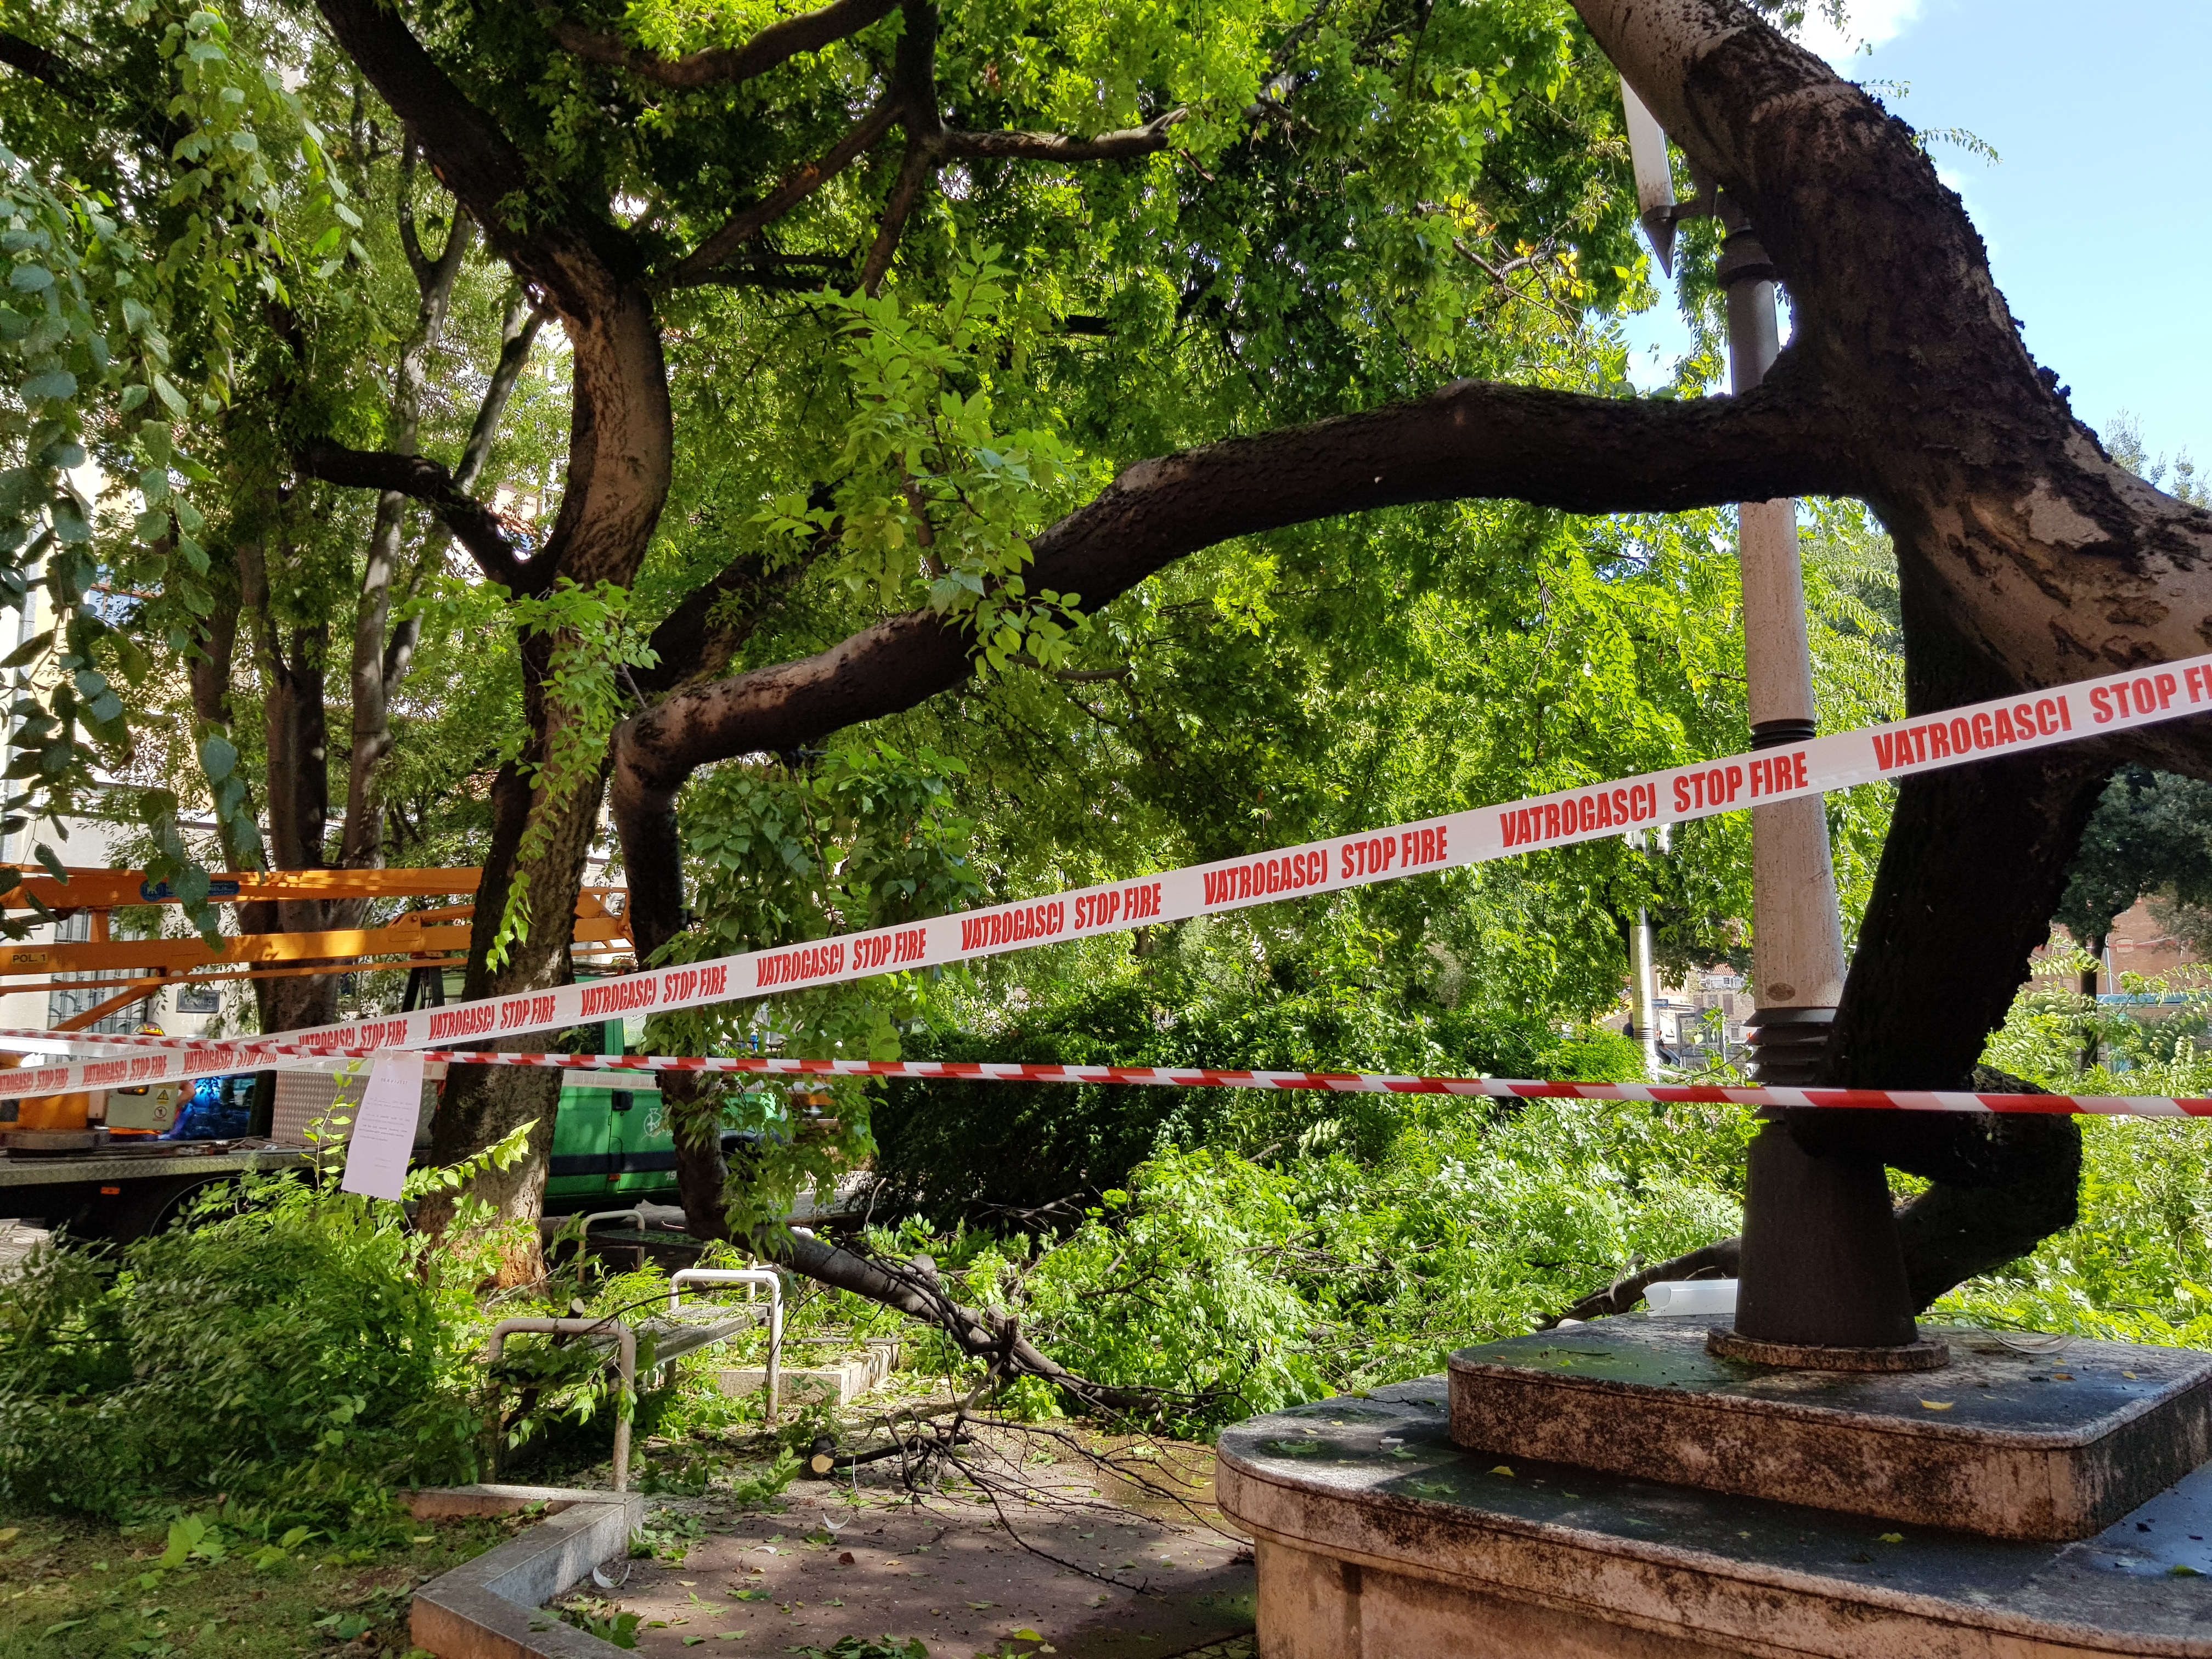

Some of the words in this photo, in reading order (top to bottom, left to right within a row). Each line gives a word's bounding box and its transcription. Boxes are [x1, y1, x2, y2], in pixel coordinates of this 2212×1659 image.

[13, 954, 37, 962] POL.
[34, 1070, 54, 1091] STOP
[52, 1067, 69, 1089] FIRE
[82, 1060, 127, 1086] VATROGASCI
[129, 1057, 150, 1081] STOP
[149, 1055, 167, 1079] FIRE
[182, 1050, 233, 1074] VATROGASCI
[297, 1028, 355, 1059] VATROGASCI
[360, 1023, 385, 1048] STOP
[384, 1019, 407, 1047] FIRE
[428, 1005, 495, 1041] VATROGASCI
[500, 1000, 531, 1030] STOP
[529, 995, 556, 1025] FIRE
[580, 978, 658, 1018] VATROGASCI
[663, 970, 699, 1005] STOP
[699, 966, 728, 997] FIRE
[758, 944, 846, 989] VATROGASCI
[853, 935, 893, 972] STOP
[893, 929, 928, 964] FIRE
[962, 901, 1065, 952] VATROGASCI
[1075, 891, 1122, 931] STOP
[1124, 883, 1163, 922] FIRE
[1204, 850, 1329, 906] VATROGASCI
[1342, 837, 1398, 881] STOP
[1401, 826, 1449, 869] FIRE
[1500, 783, 1658, 849] VATROGASCI
[1673, 766, 1744, 814] STOP
[1749, 752, 1809, 799] FIRE
[1872, 696, 2073, 772] VATROGASCI
[2089, 673, 2177, 724] STOP
